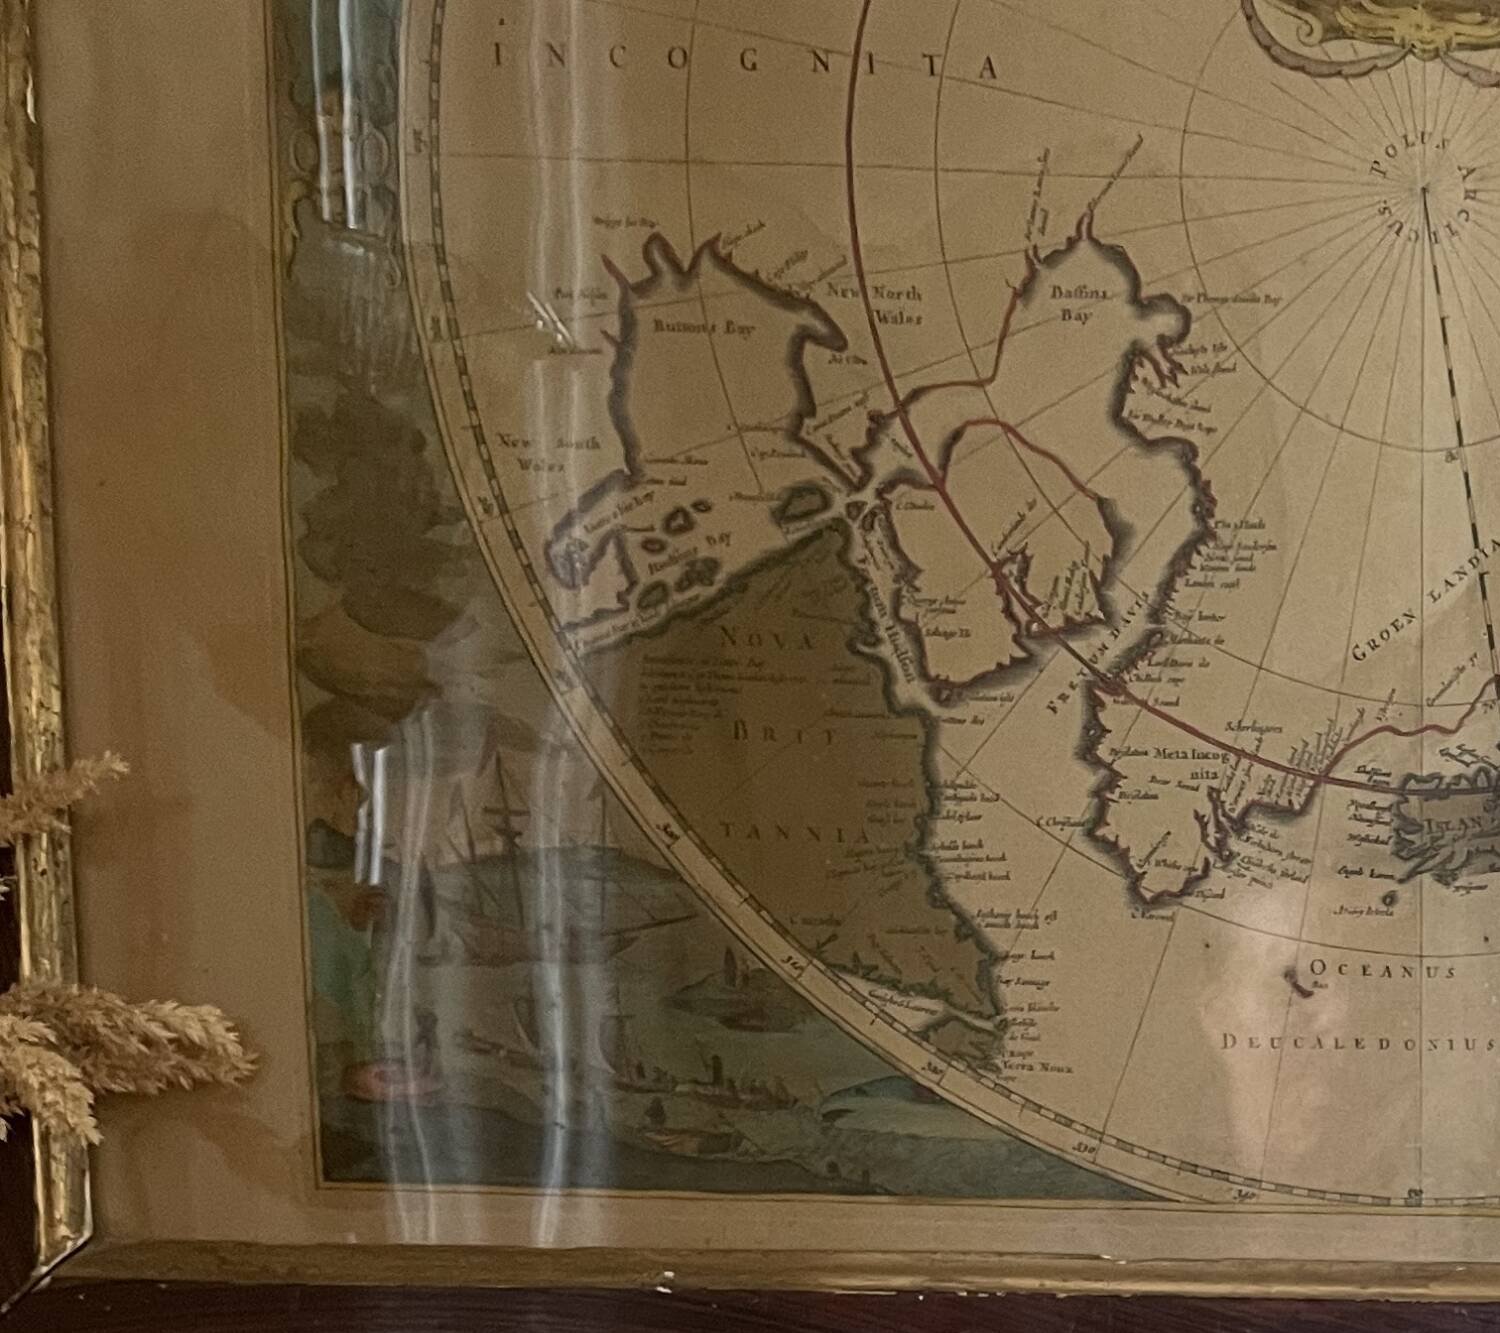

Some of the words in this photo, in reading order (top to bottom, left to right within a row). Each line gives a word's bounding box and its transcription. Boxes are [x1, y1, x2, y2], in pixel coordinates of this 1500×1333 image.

[494, 42, 998, 80] INCOGNITA
[719, 625, 813, 650] NOVA
[1309, 958, 1457, 980] OCEANUS
